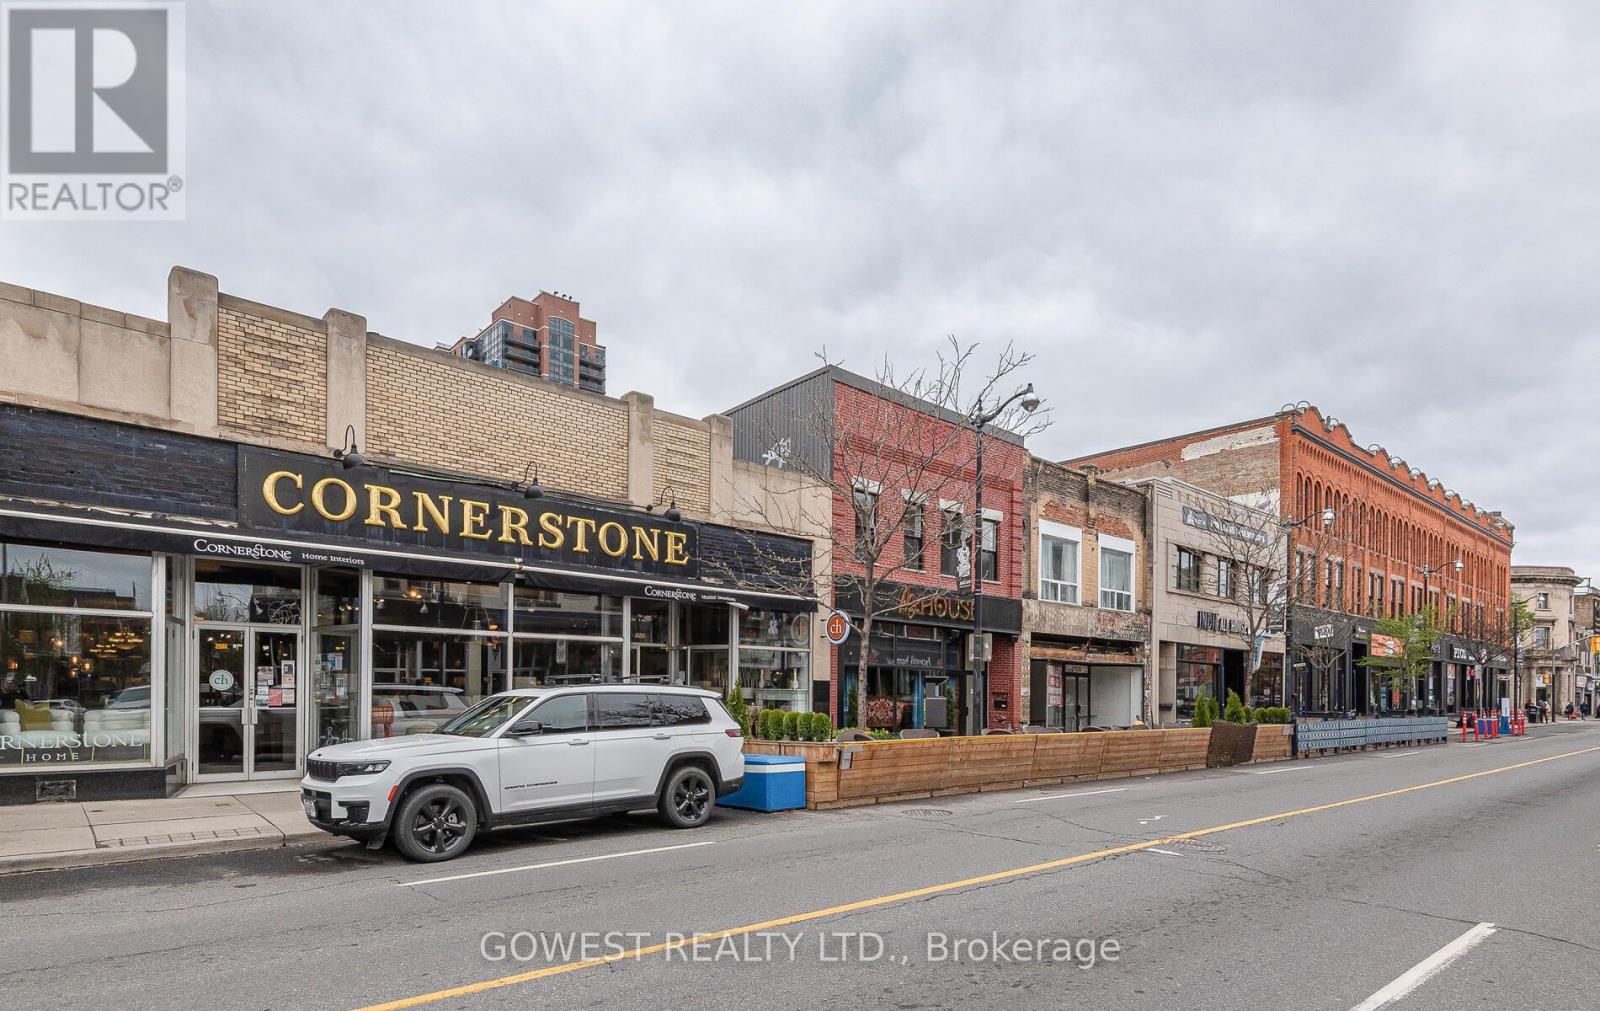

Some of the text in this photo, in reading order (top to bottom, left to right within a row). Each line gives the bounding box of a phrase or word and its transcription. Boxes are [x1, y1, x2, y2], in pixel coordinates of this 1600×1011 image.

[263, 471, 689, 566] CORNERSTONE
[302, 552, 328, 561] Home
[329, 555, 365, 566] Interiors
[213, 674, 229, 685] ch
[26, 752, 80, 762] HOME
